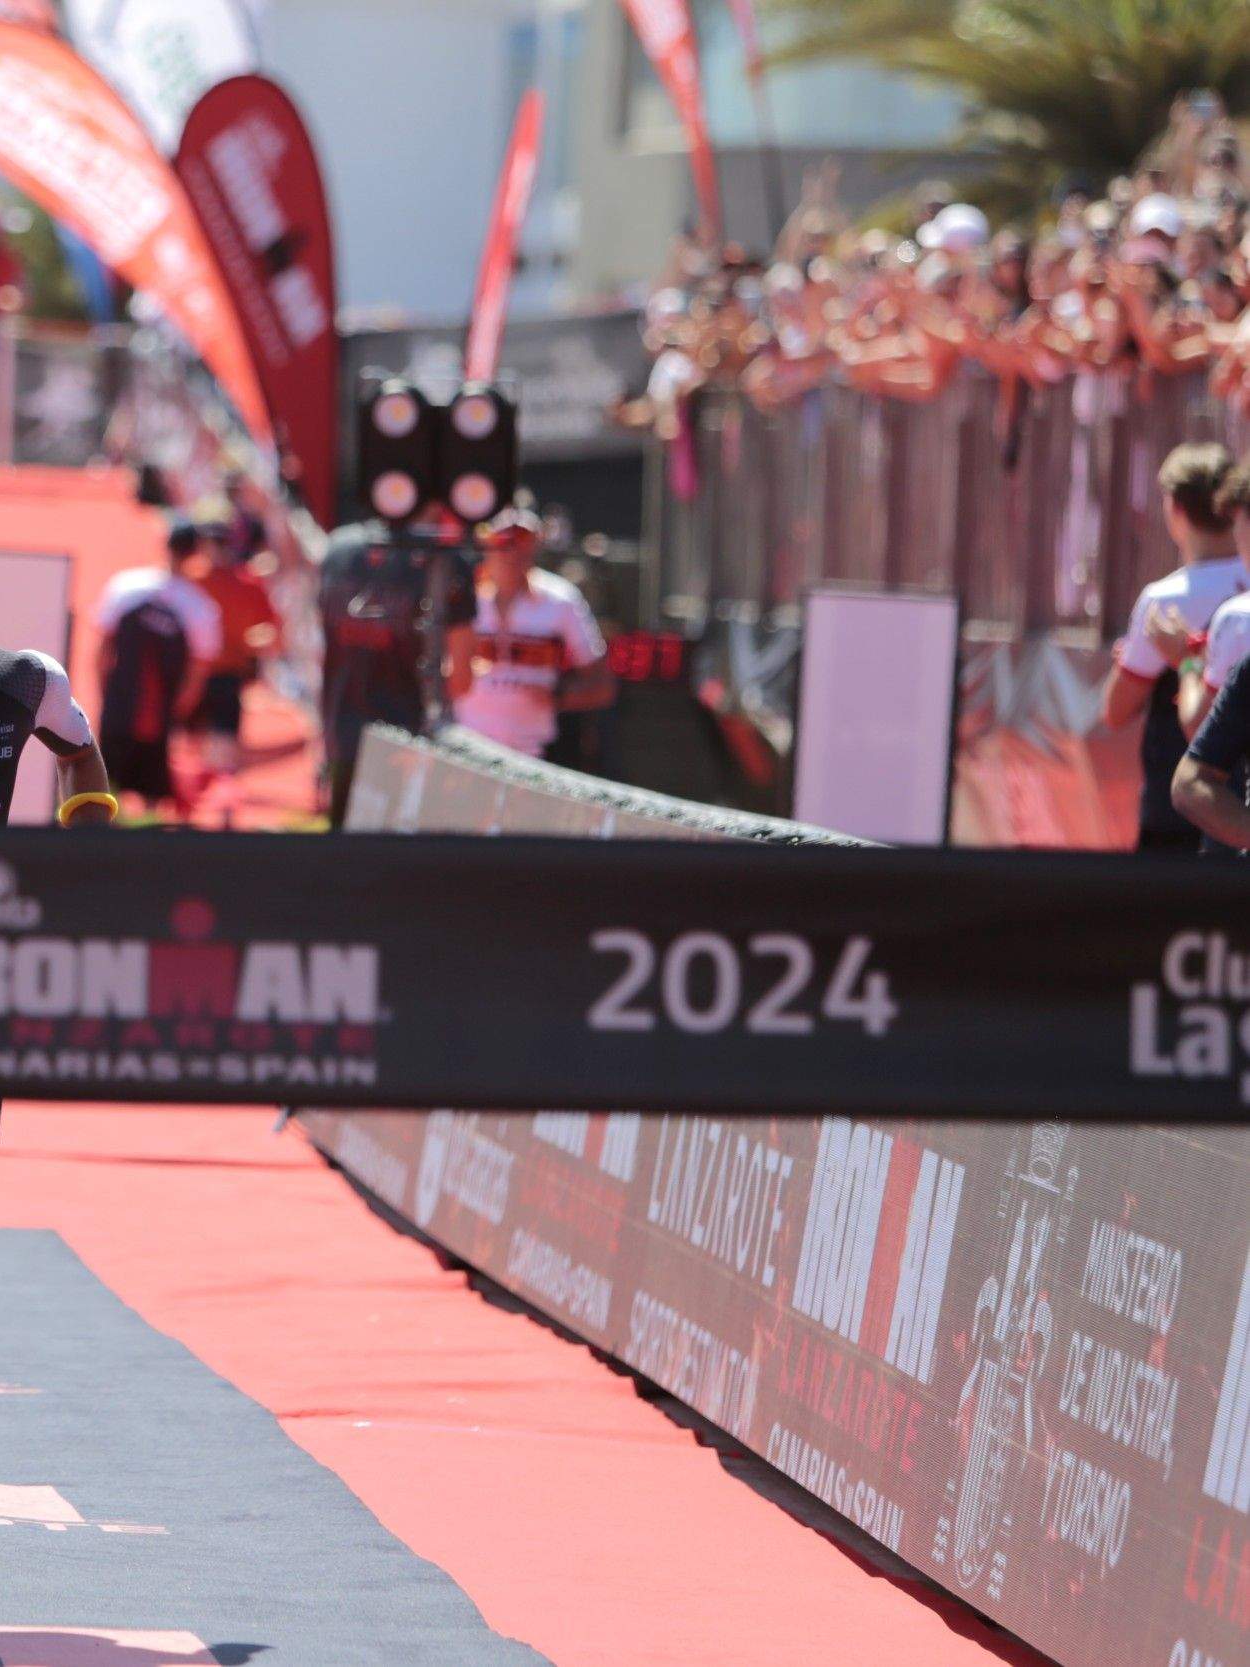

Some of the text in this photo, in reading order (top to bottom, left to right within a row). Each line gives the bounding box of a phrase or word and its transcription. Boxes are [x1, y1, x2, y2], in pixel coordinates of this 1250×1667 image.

[588, 929, 898, 1036] 2024
[218, 1053, 377, 1085] SPAIN
[648, 1112, 794, 1287] LANZAROTE
[792, 1114, 965, 1384] IRONMAN
[1081, 1218, 1183, 1335] MINISTERIO
[1059, 1331, 1180, 1468] DE INDUSTRIA
[767, 1421, 904, 1553] CANARIAS SPAIN
[1051, 1451, 1132, 1567] TURISMO
